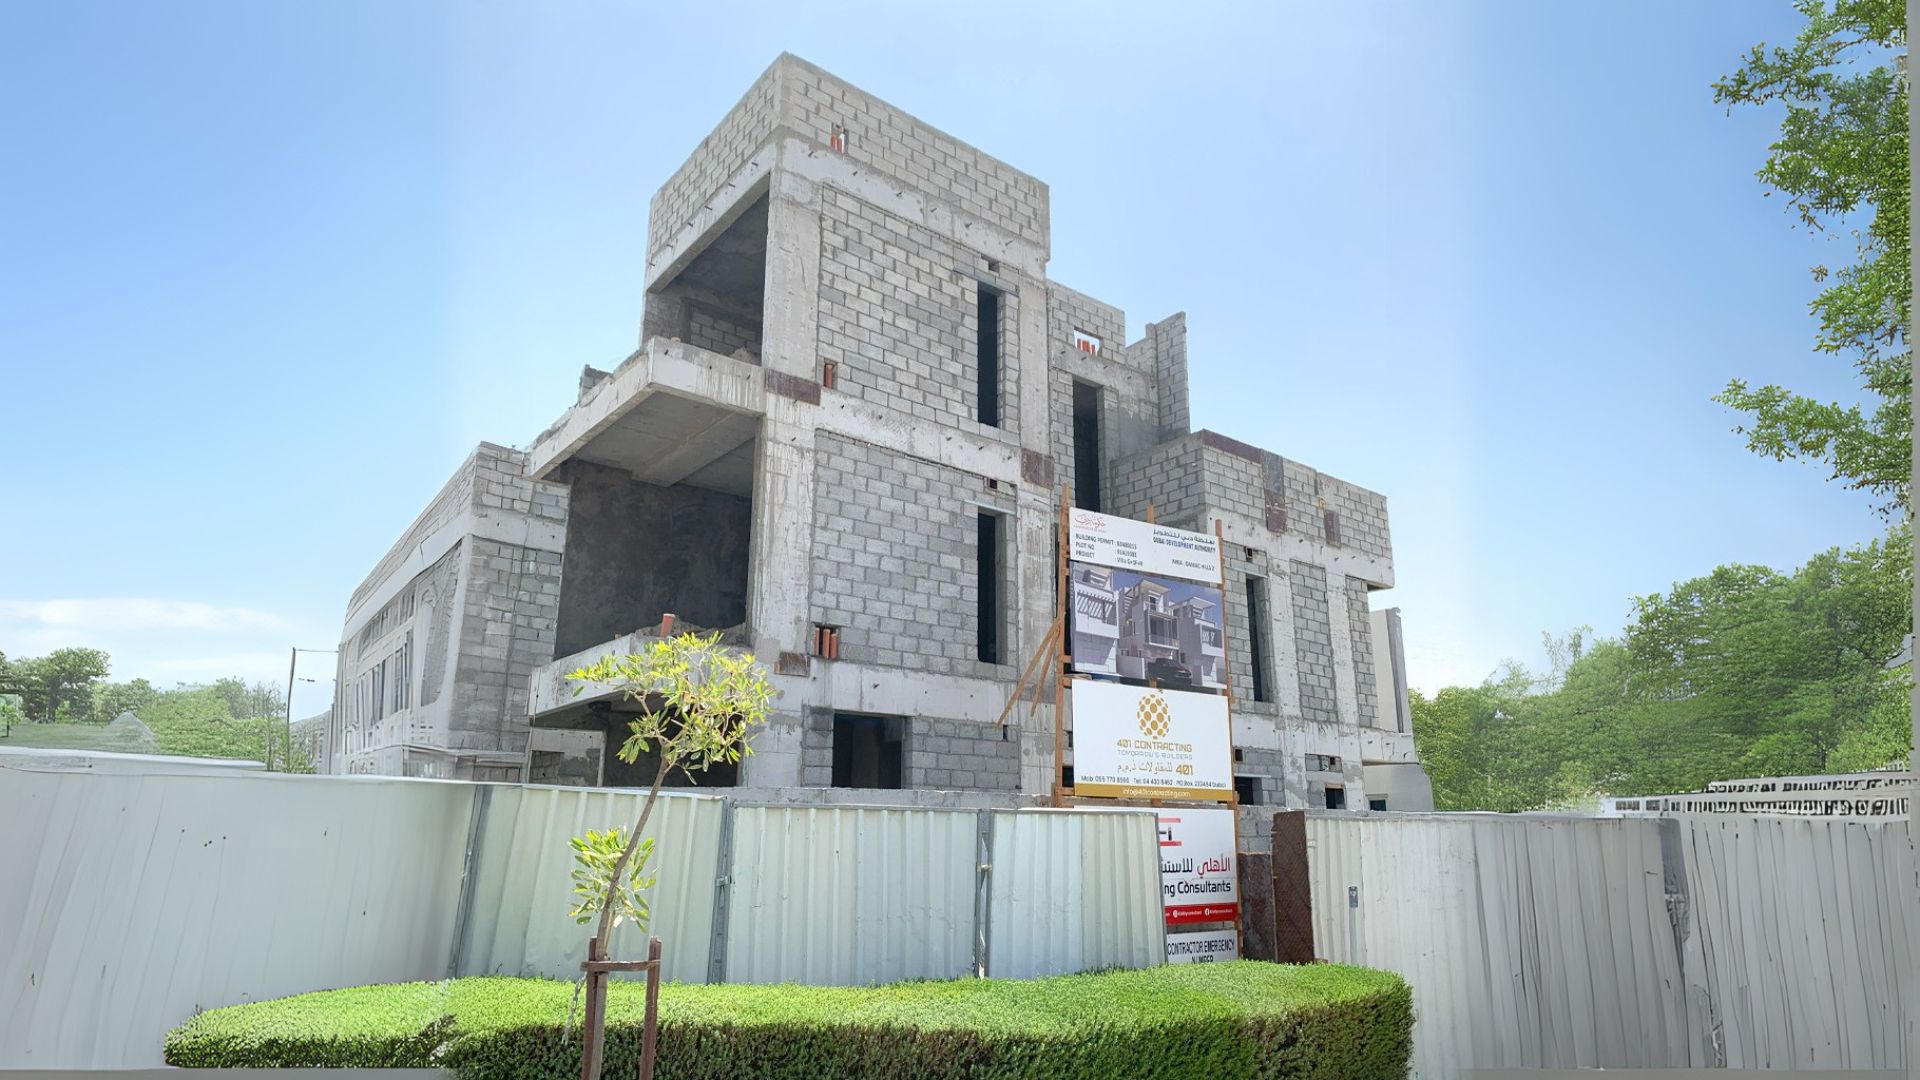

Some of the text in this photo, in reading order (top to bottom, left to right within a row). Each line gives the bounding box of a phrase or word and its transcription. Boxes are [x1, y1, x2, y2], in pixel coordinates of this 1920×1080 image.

[1075, 532, 1097, 543] BUILDING
[1097, 537, 1114, 546] PERMIT
[1075, 541, 1087, 549] PLOT
[1153, 536, 1216, 554] DUBAI DEVELOPMENT AUTHORITY
[1075, 549, 1095, 559] PROJECT
[1116, 738, 1193, 753] 401 CONTRACTING
[1161, 752, 1193, 760] BUILDERS
[1175, 764, 1194, 776] 401
[1197, 852, 1231, 879] الأهلي
[1164, 879, 1231, 898] ng Consultants
[1167, 938, 1235, 956] CONTRACTOR EMERGENCY
